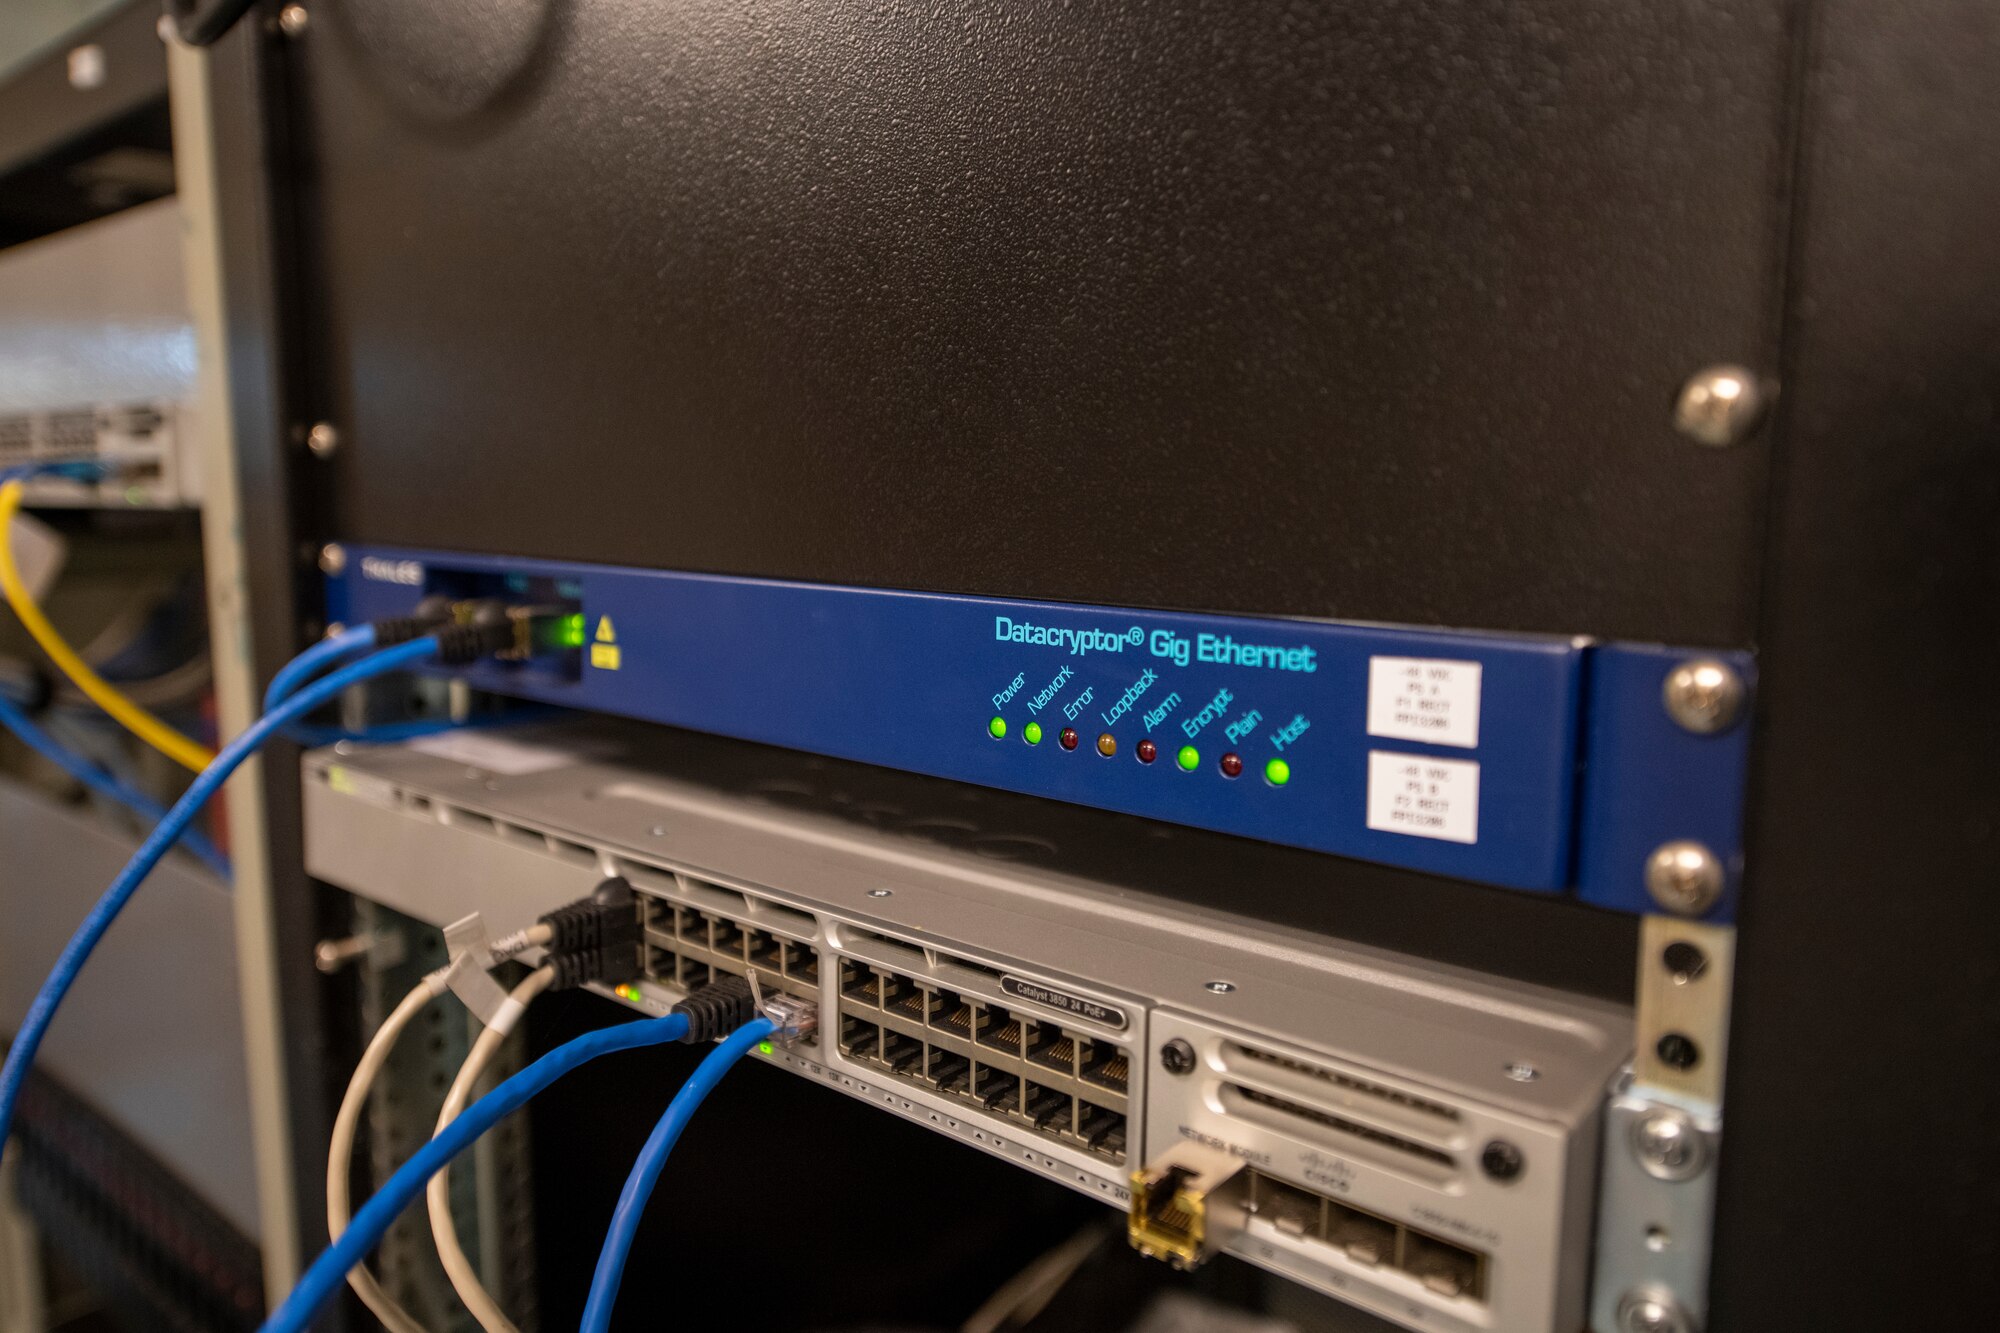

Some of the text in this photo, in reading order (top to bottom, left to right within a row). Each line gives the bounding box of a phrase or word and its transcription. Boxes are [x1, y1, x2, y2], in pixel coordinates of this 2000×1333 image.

[1149, 629, 1191, 667] Gig
[1196, 632, 1318, 673] Ethernet
[991, 671, 1025, 711] Power
[1026, 665, 1074, 716] Network
[1062, 686, 1095, 721] Error
[1100, 668, 1159, 727] Loopback
[1142, 692, 1182, 733] Alarm
[1181, 688, 1234, 739] Encrypt
[1224, 709, 1263, 745] Plain
[1270, 714, 1311, 751] Host
[1017, 983, 1106, 1018] Catalyst 3850 24 PoE+
